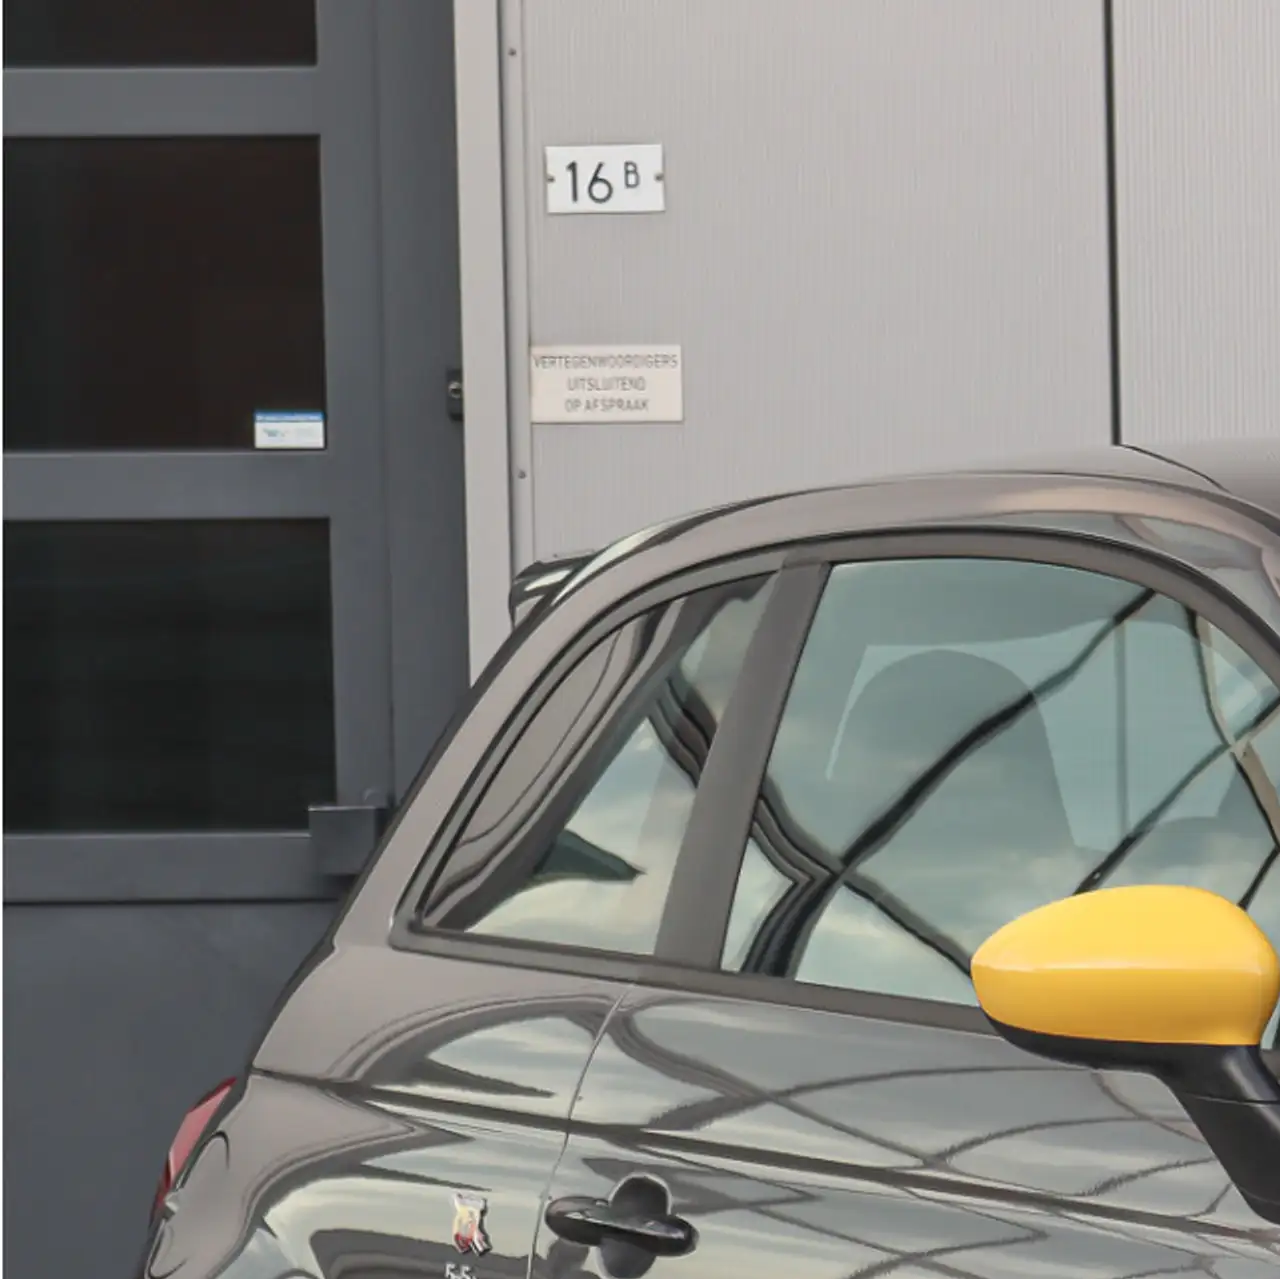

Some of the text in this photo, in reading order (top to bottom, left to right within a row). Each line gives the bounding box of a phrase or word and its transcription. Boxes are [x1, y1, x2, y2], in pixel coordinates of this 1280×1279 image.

[532, 354, 678, 369] VERTEGENWOORDIGERS
[567, 376, 647, 391] UITSLUITEND
[564, 398, 650, 412] OP AFSPRAAK
